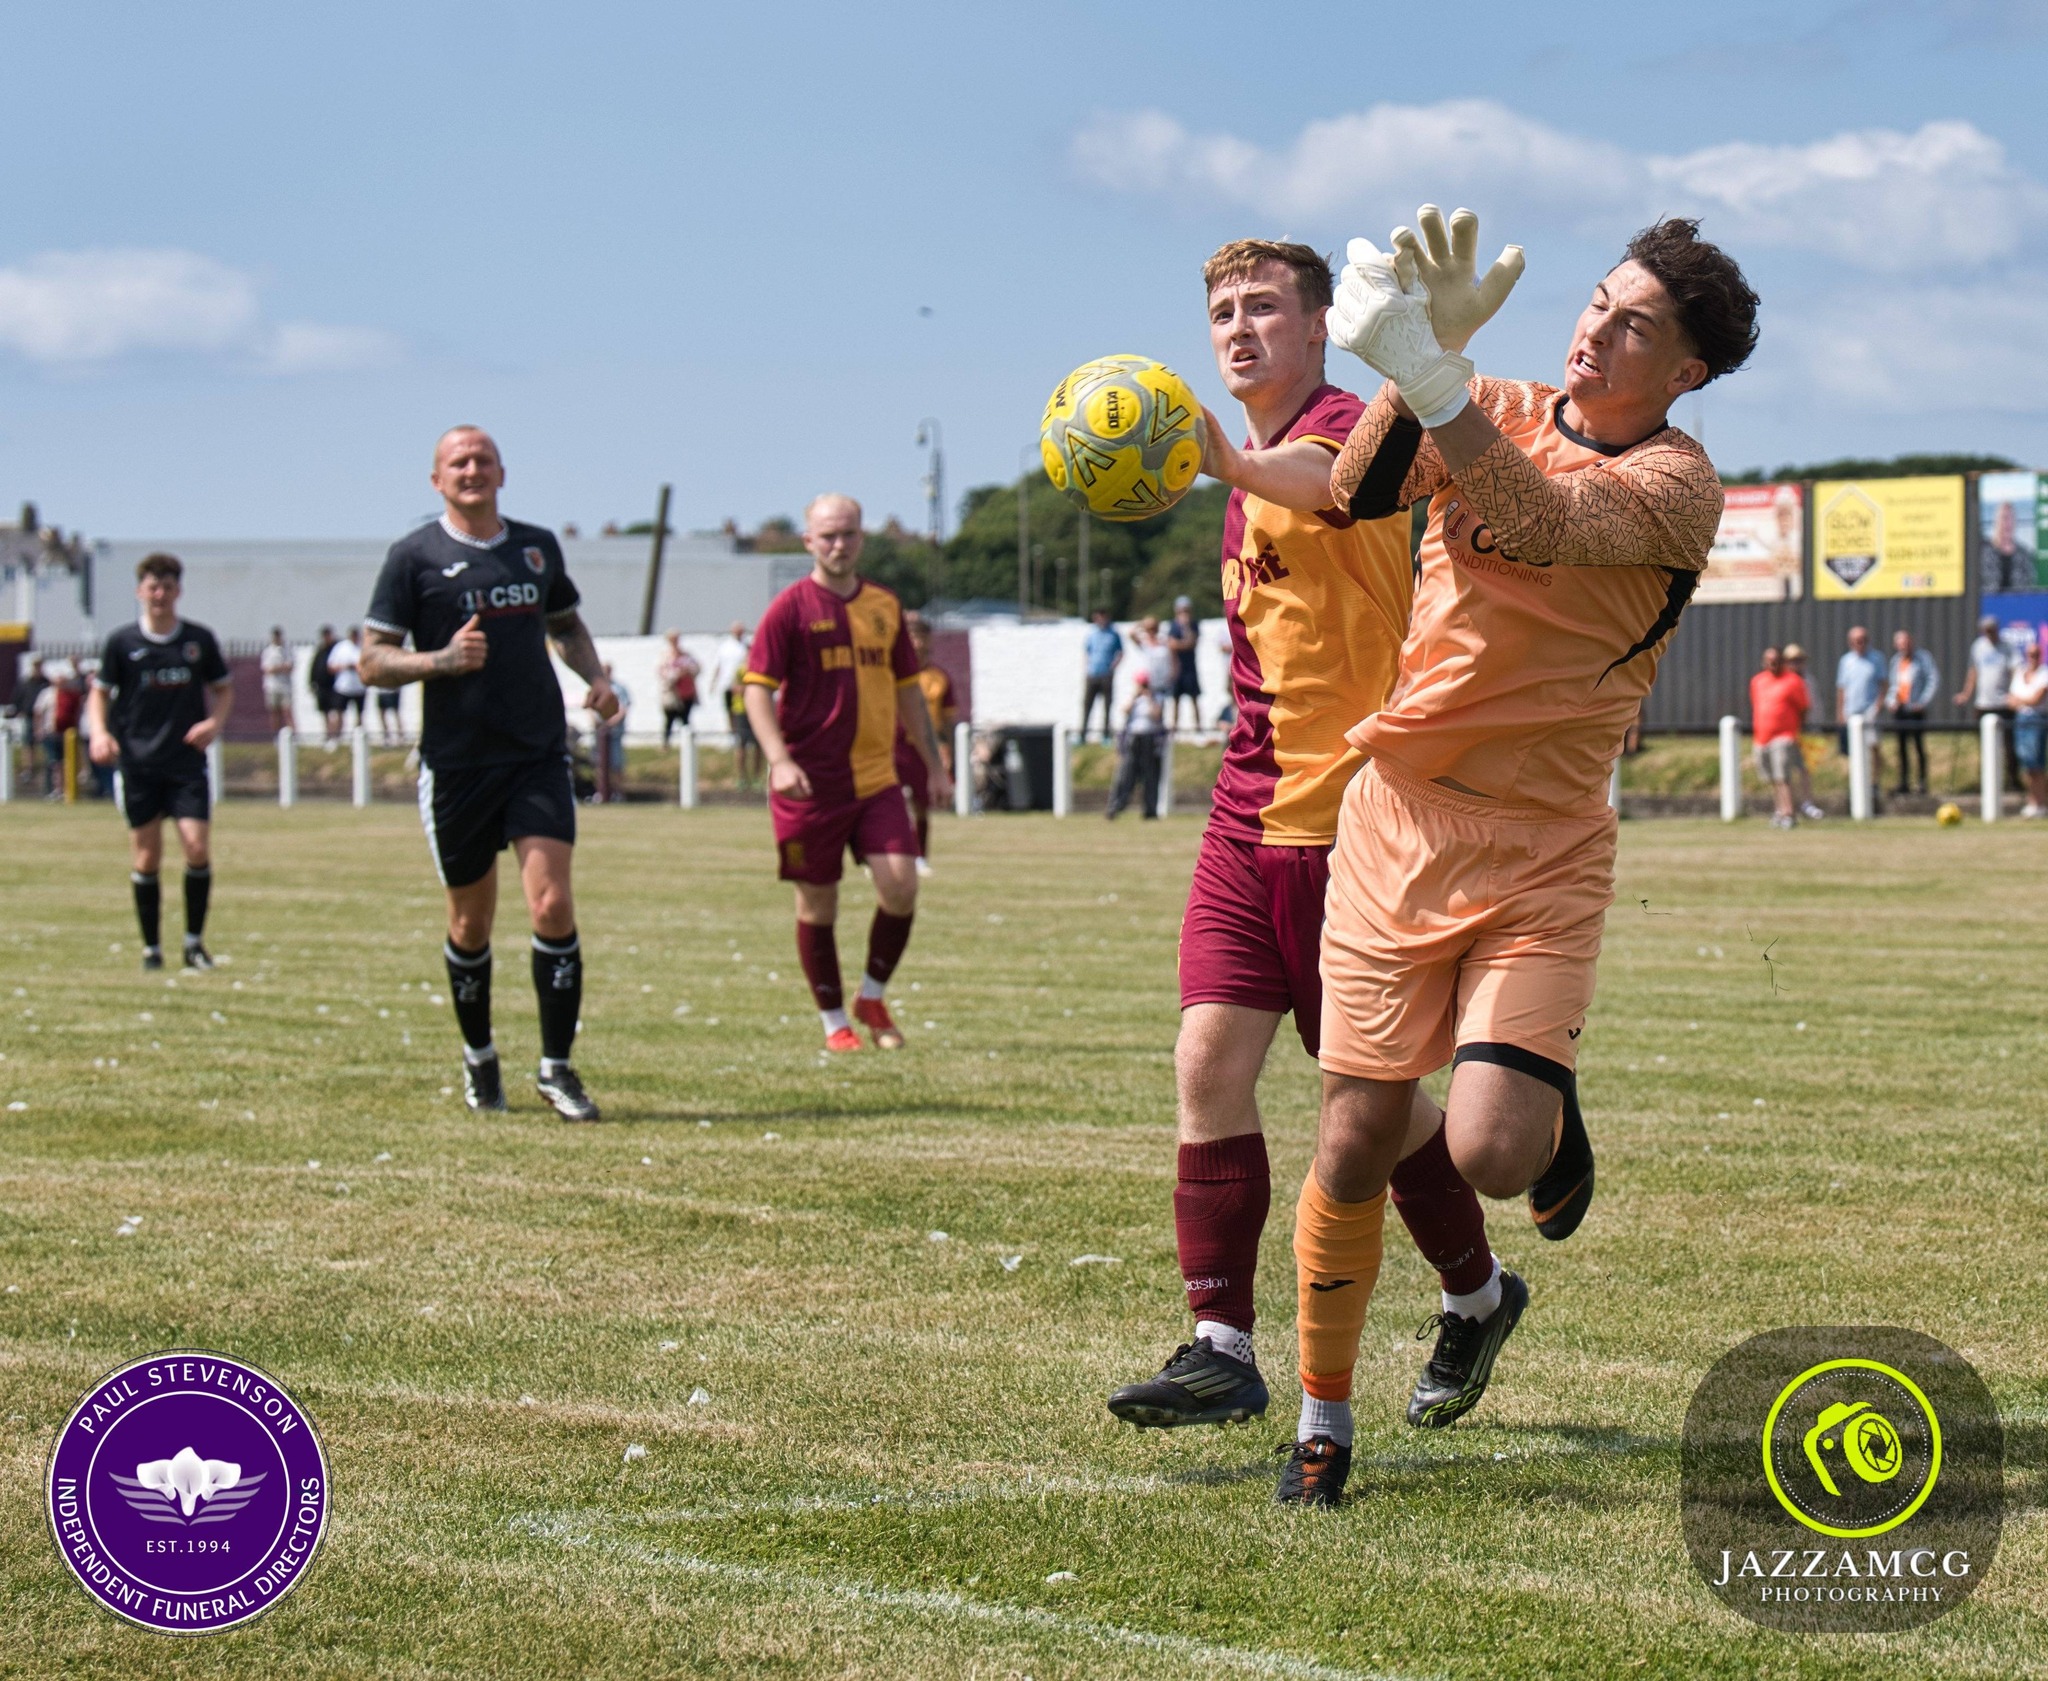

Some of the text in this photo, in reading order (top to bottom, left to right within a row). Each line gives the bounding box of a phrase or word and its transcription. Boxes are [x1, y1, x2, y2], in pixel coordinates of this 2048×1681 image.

[1107, 391, 1119, 428] DELTA
[490, 582, 540, 609] CSD
[1420, 1386, 1482, 1424] F50
